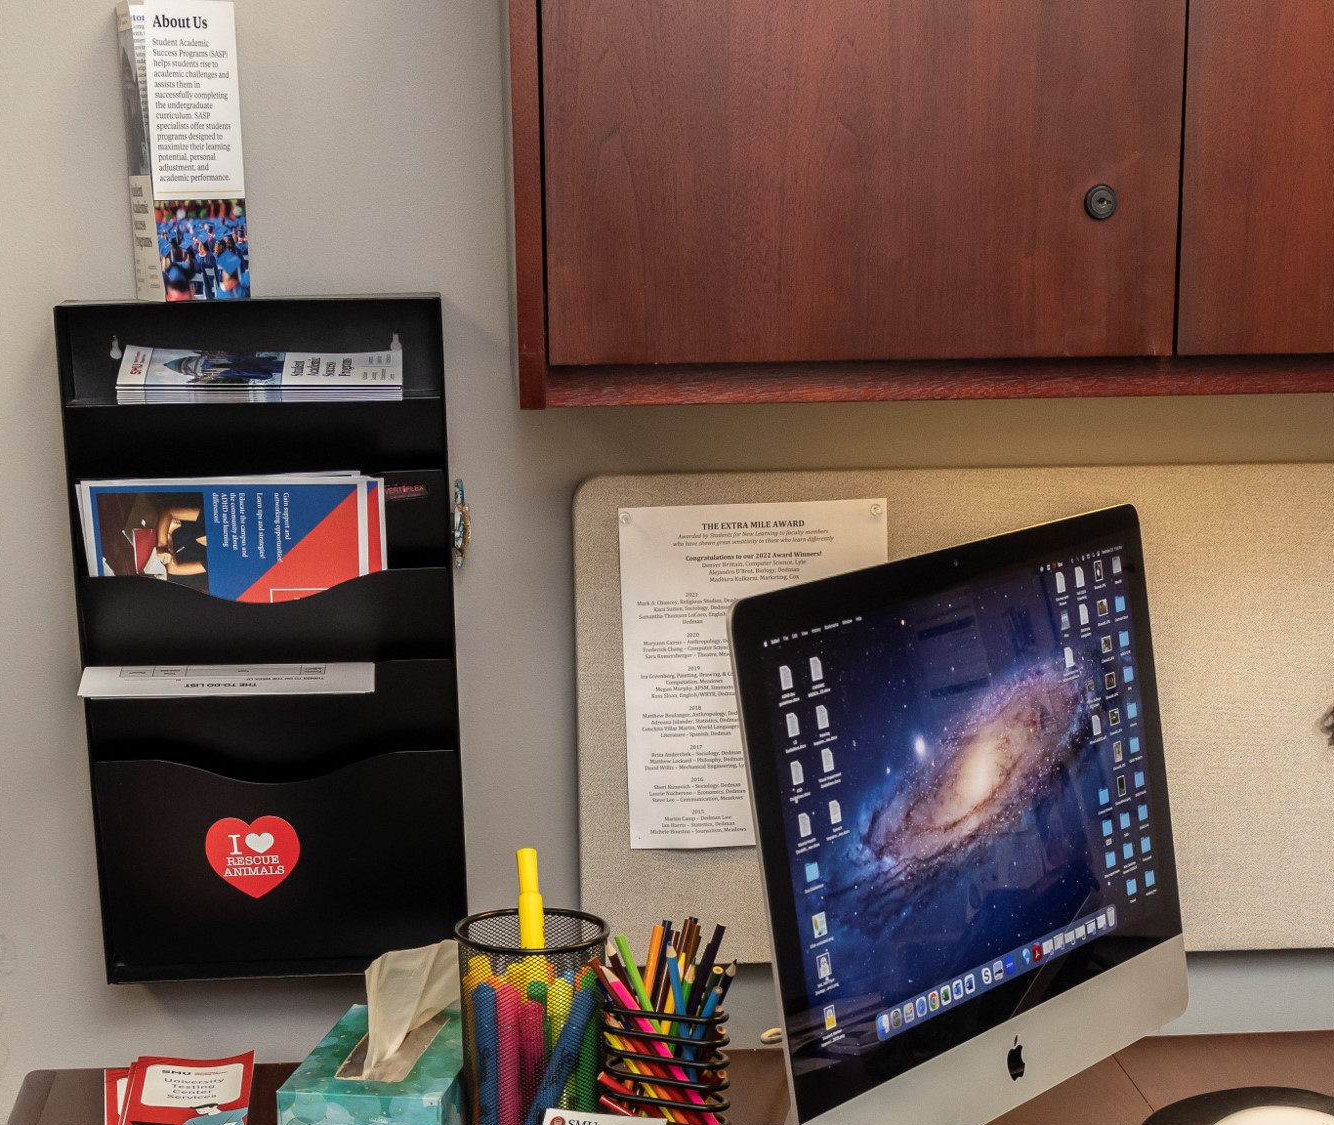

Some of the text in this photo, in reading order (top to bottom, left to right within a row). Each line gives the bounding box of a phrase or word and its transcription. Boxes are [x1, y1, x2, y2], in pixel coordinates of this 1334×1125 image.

[152, 15, 191, 29] About
[193, 16, 208, 29] Us
[152, 38, 209, 47] Student Academic
[153, 49, 177, 57] Success
[179, 50, 208, 59] Programs
[153, 59, 171, 68] helps
[172, 60, 199, 68] students
[200, 60, 211, 68] rise
[154, 70, 184, 78] academic
[185, 70, 217, 79] challenges
[154, 80, 175, 88] assists
[701, 520, 805, 530] THE EXTRA MILE AWARD
[258, 532, 266, 559] strategies!
[274, 525, 283, 563] opportunities!
[685, 554, 735, 563] Congratulations
[228, 834, 243, 855] I
[226, 855, 280, 866] RESCUE
[224, 865, 285, 877] ANIMALS
